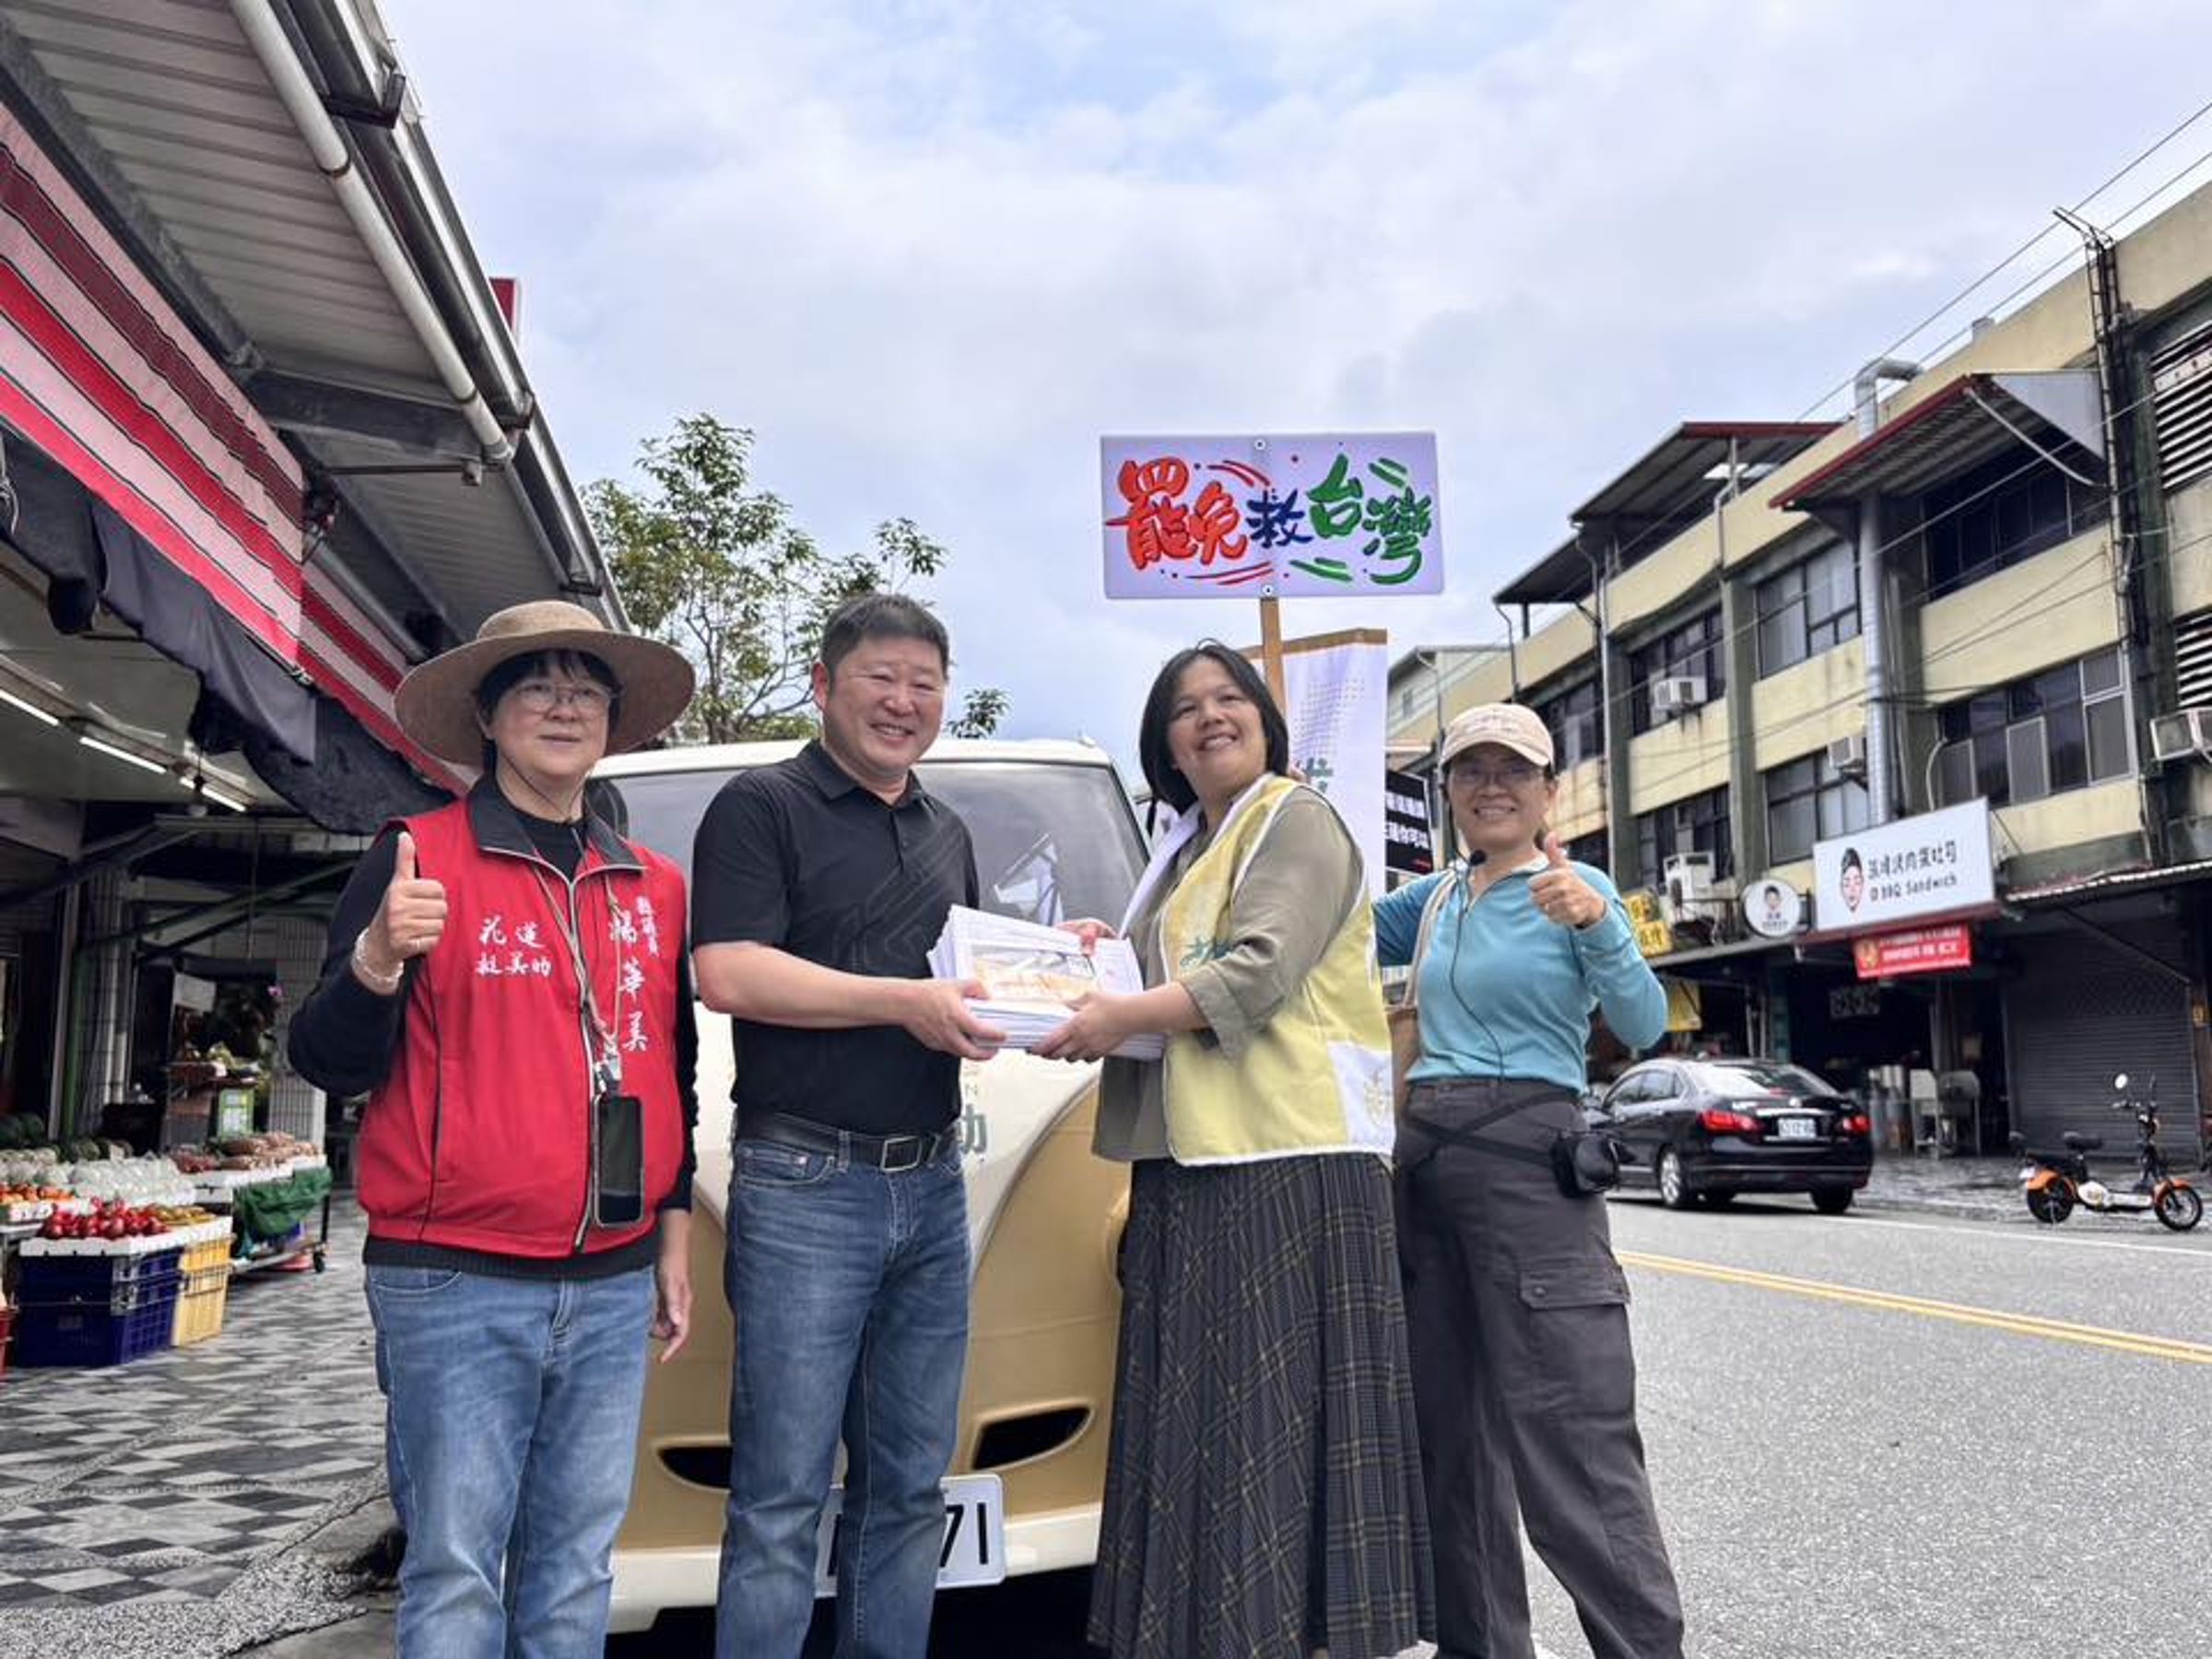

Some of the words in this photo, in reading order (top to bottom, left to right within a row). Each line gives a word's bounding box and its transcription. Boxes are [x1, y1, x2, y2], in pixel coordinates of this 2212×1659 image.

[1106, 454, 1432, 585] 罷免救台灣
[1905, 872, 1957, 895] Sandwich
[478, 915, 546, 948] 花蓮
